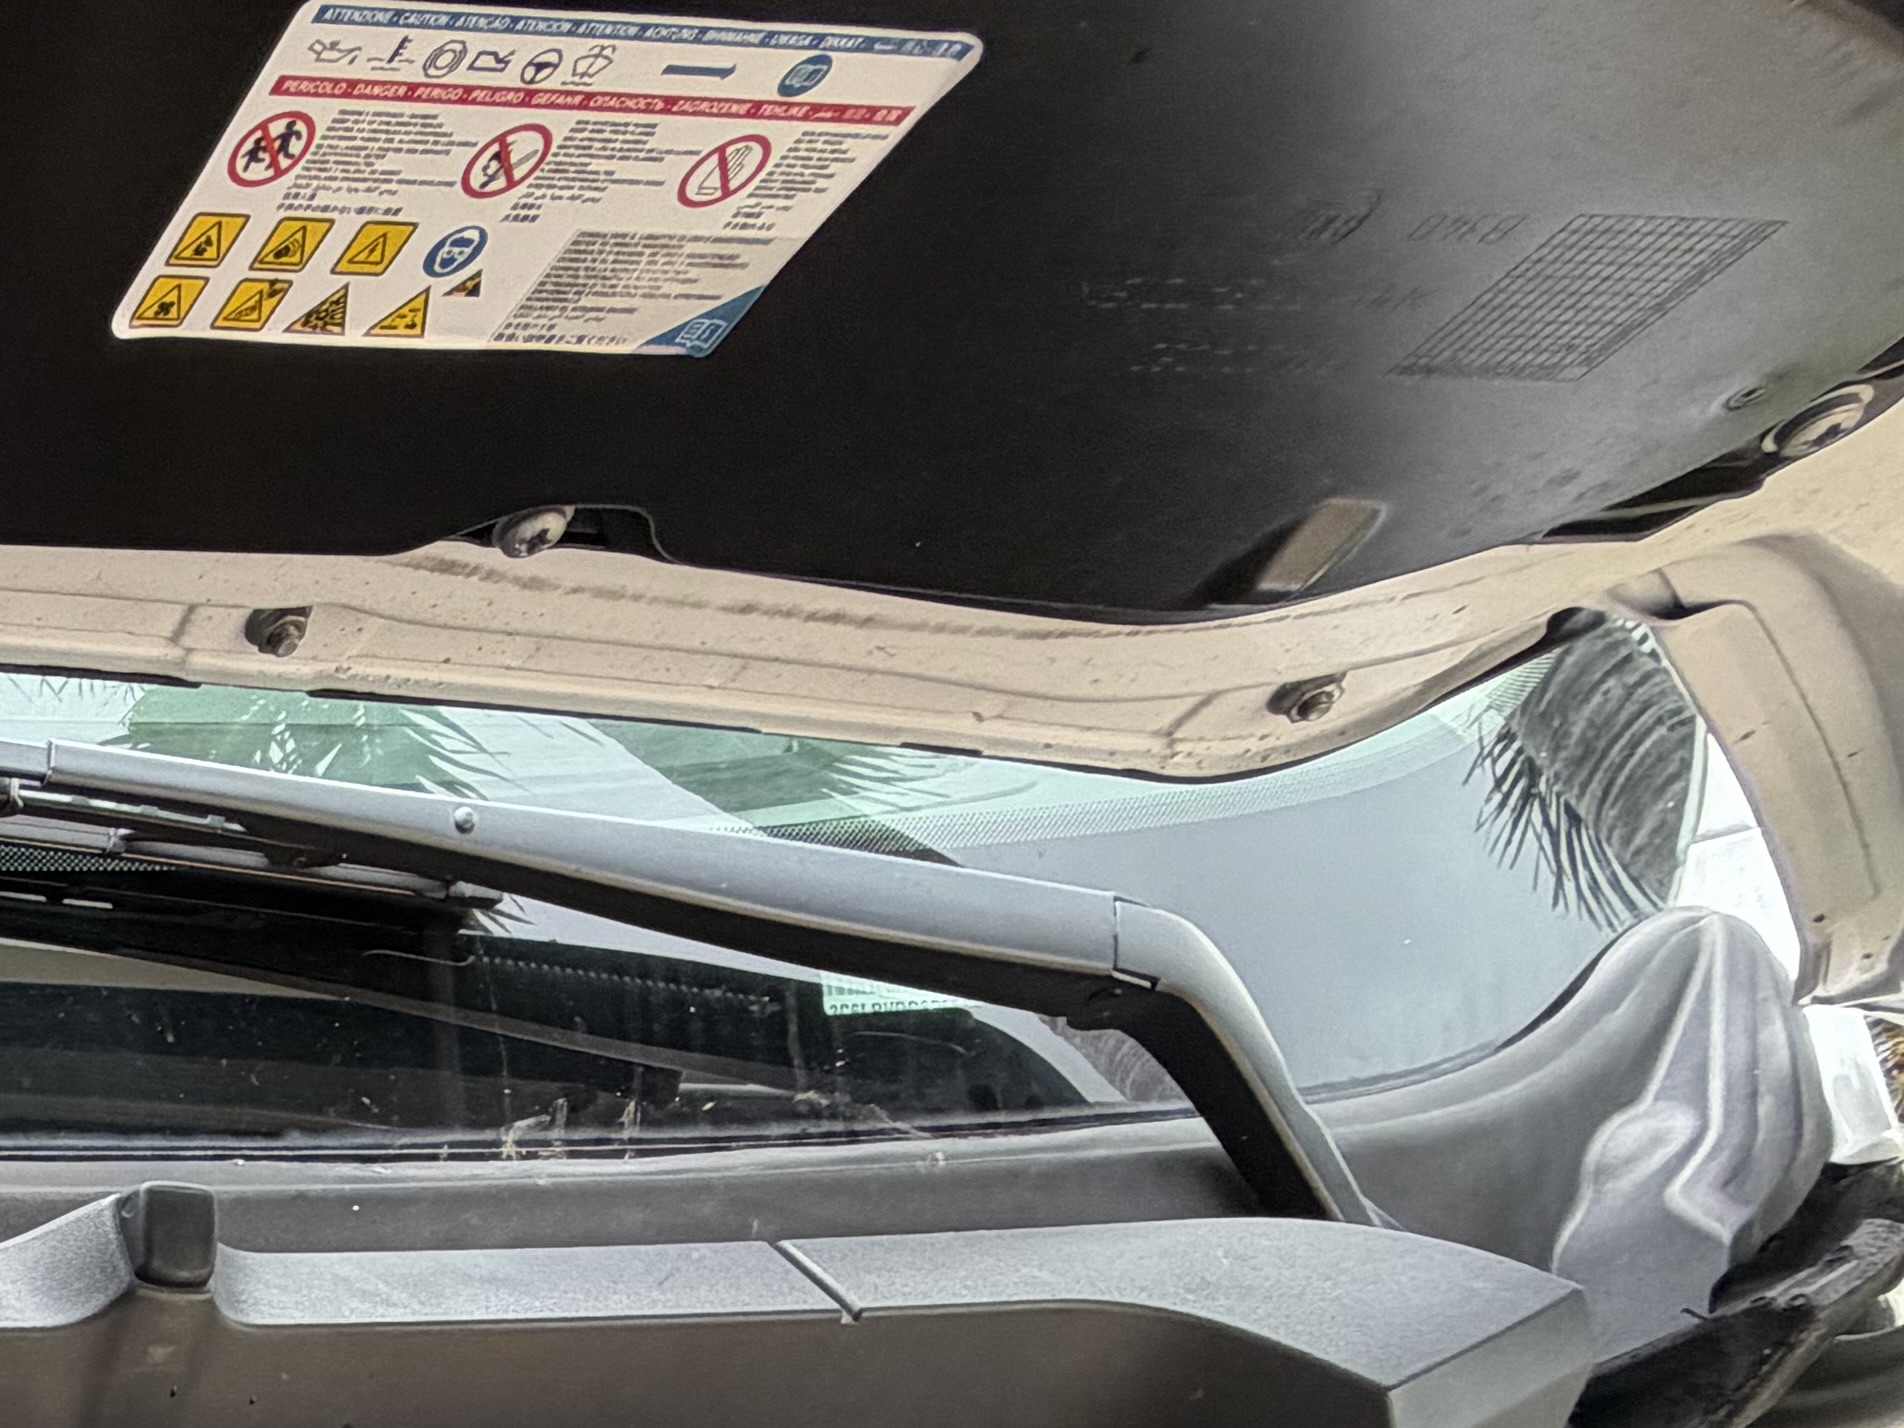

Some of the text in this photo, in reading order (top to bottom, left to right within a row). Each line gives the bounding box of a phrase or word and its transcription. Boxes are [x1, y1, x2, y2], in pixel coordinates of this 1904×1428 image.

[399, 13, 447, 27] CAUTION
[281, 77, 585, 107] PERICOLO DANGER PERIGO PELIGRO GEFAHR
